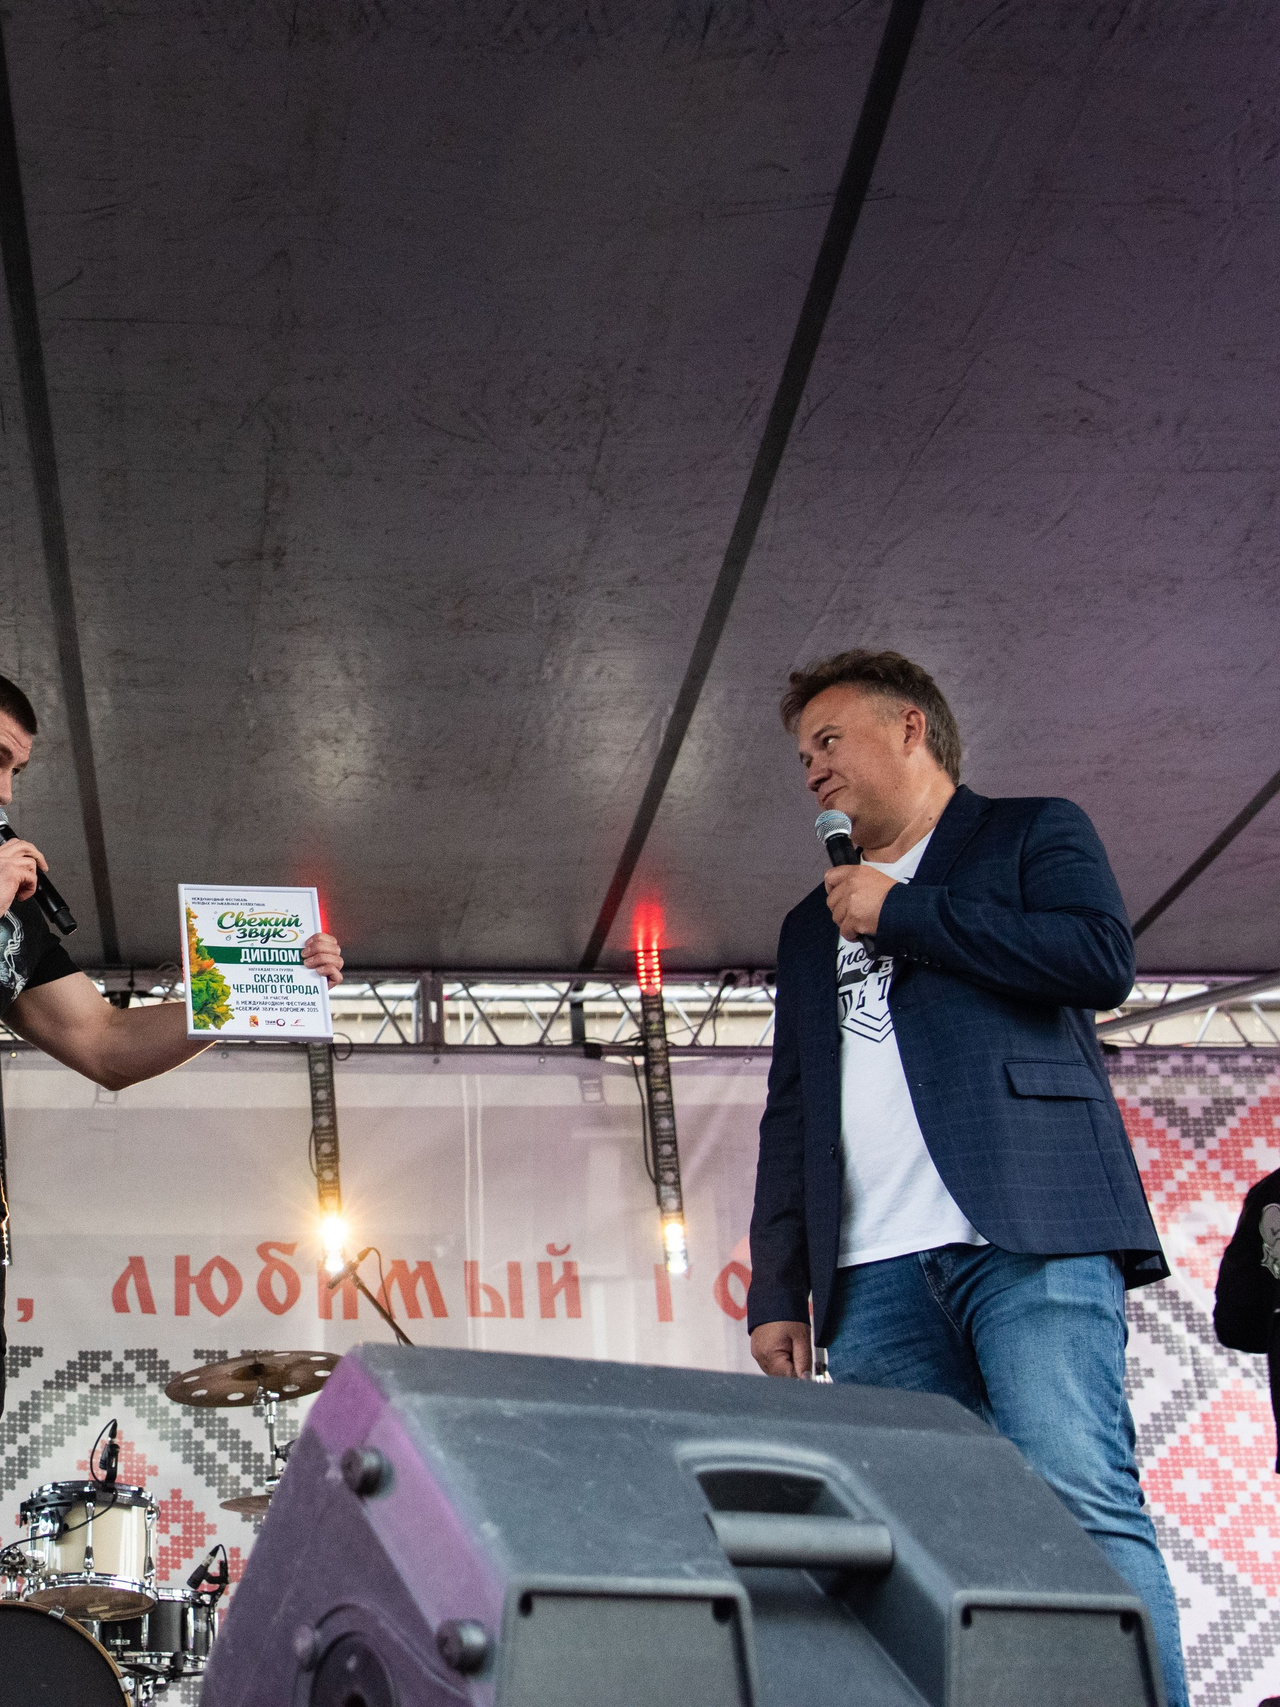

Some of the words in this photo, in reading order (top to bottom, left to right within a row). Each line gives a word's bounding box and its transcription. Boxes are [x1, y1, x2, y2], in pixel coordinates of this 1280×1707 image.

[217, 911, 303, 930] Свежий
[236, 928, 287, 944] звук
[240, 948, 300, 963] ДИПЛОМ
[253, 973, 294, 984] СКАЗКИ
[232, 983, 277, 994] ЧЕРНОГО
[280, 984, 320, 995] ГОРОДА
